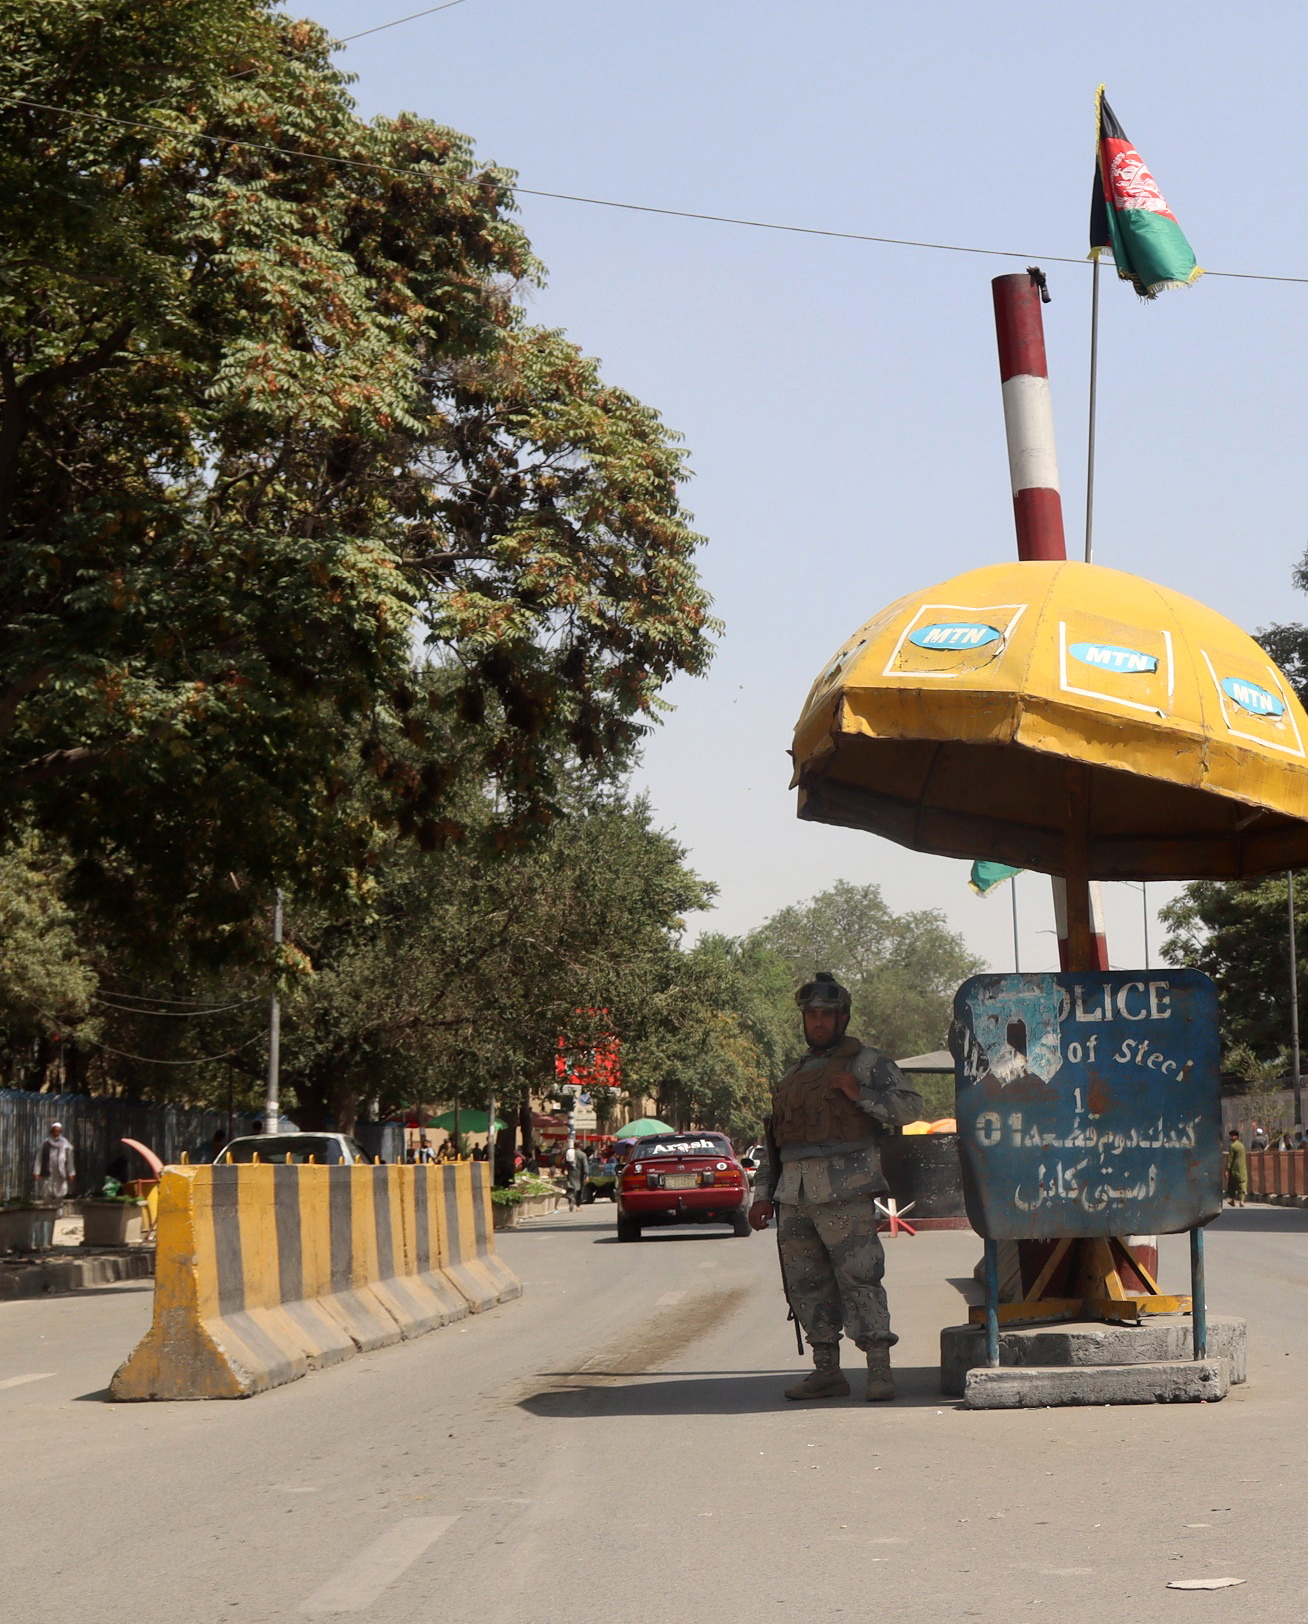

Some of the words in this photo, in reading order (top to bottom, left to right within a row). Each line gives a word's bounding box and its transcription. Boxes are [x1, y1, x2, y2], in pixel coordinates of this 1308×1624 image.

[922, 628, 988, 644] MTN
[1085, 646, 1149, 671] MTN
[1232, 681, 1274, 712] MTN
[1058, 980, 1173, 1023] LICE
[1067, 1034, 1098, 1064] of
